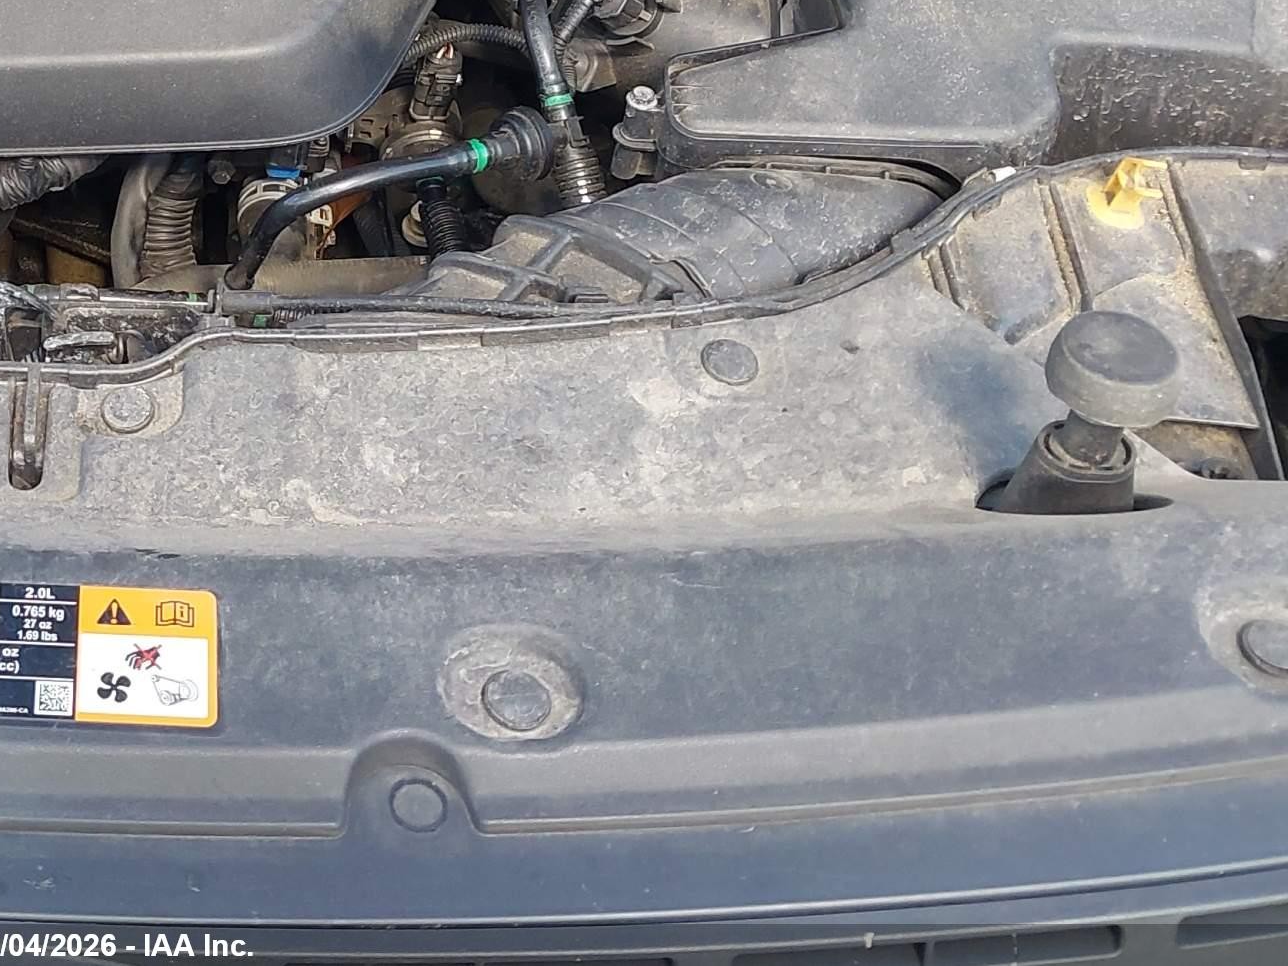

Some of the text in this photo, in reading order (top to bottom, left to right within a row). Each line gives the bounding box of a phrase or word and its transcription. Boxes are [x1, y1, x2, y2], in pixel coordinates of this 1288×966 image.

[24, 587, 55, 601] 2.0L
[12, 605, 64, 620] 0.765 kg
[23, 619, 36, 628] 27
[17, 630, 57, 641] 1.69 lbs
[2, 648, 19, 657] oz
